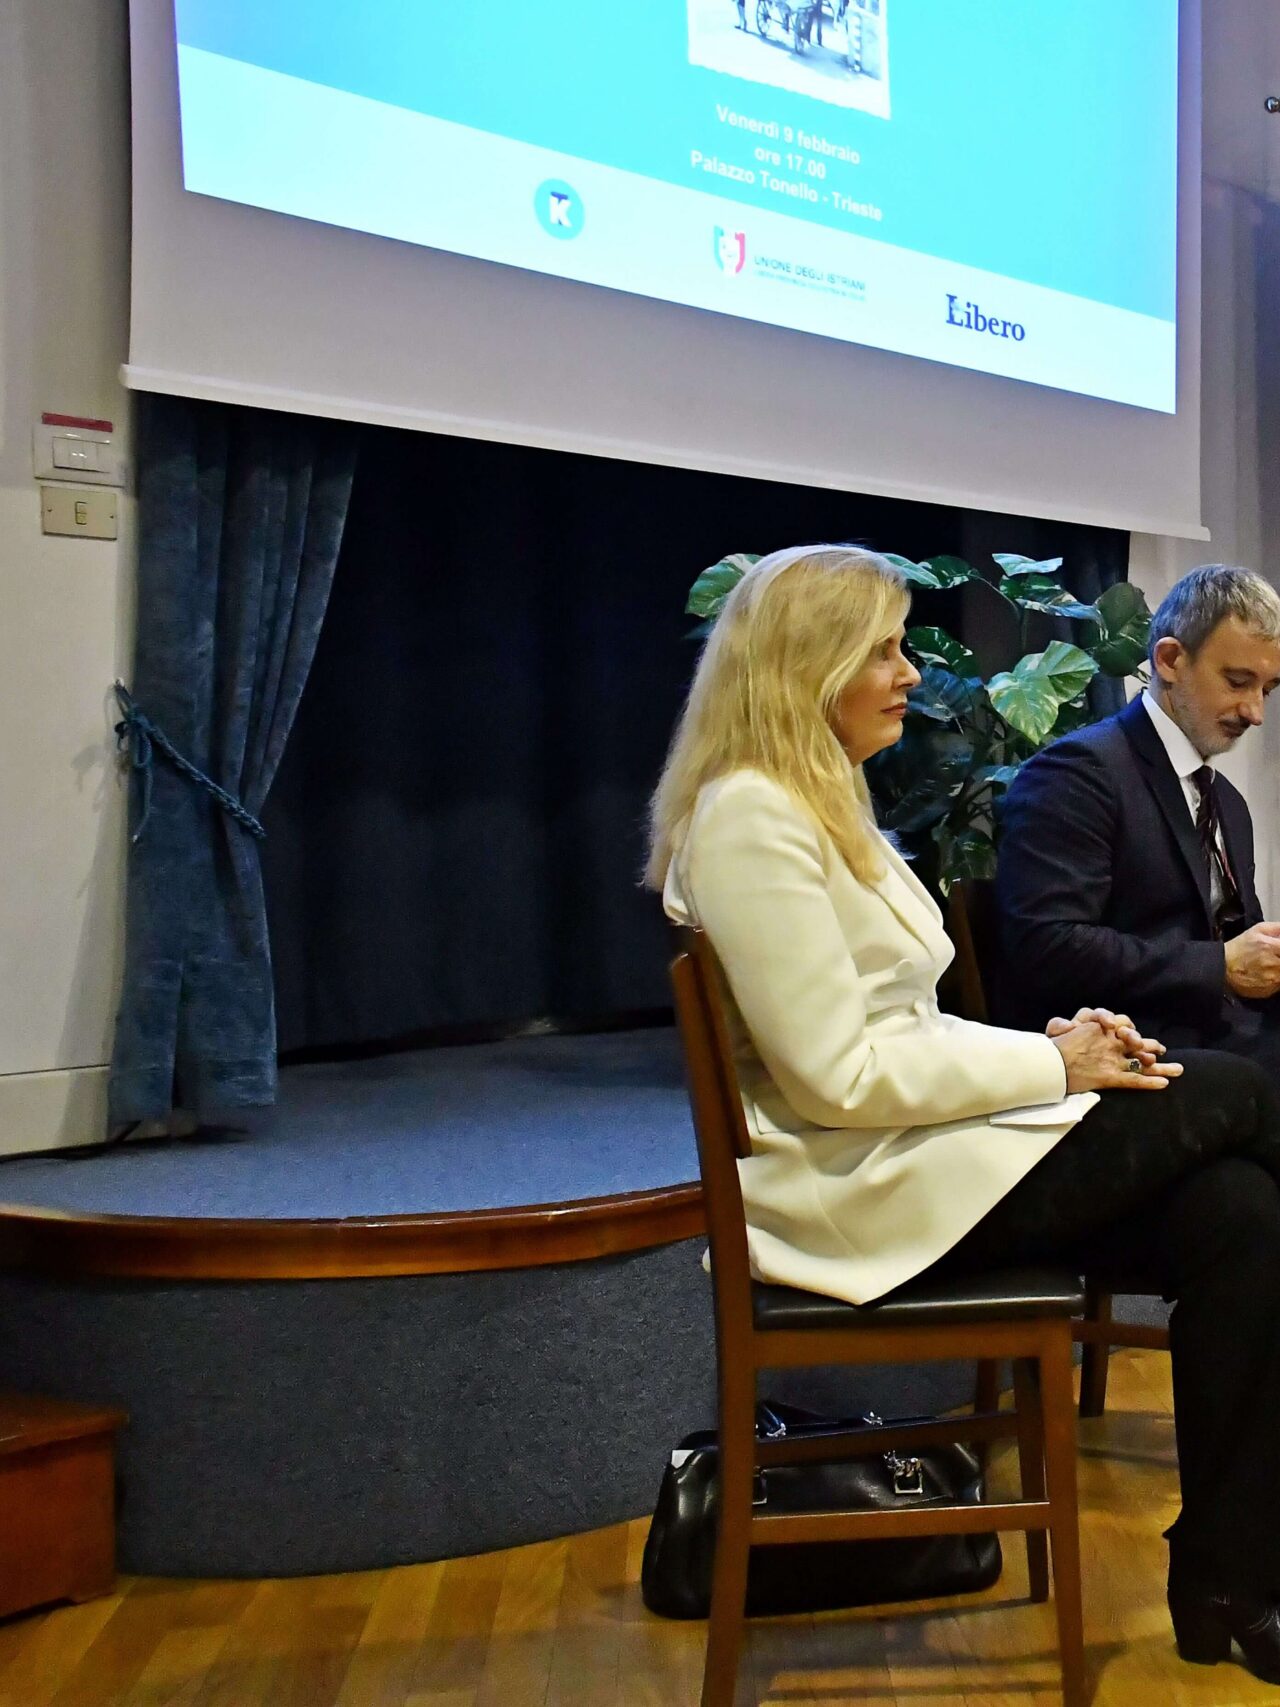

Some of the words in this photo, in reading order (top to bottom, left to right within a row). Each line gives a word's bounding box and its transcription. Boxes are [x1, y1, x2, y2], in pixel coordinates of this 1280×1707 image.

[754, 147, 781, 166] ore
[786, 152, 826, 180] 17.00
[783, 126, 793, 143] 9
[796, 130, 861, 165] febbraio
[690, 149, 755, 184] Palazzo
[760, 169, 819, 203] Tonello
[832, 191, 883, 221] Trieste
[946, 293, 1026, 341] Libero
